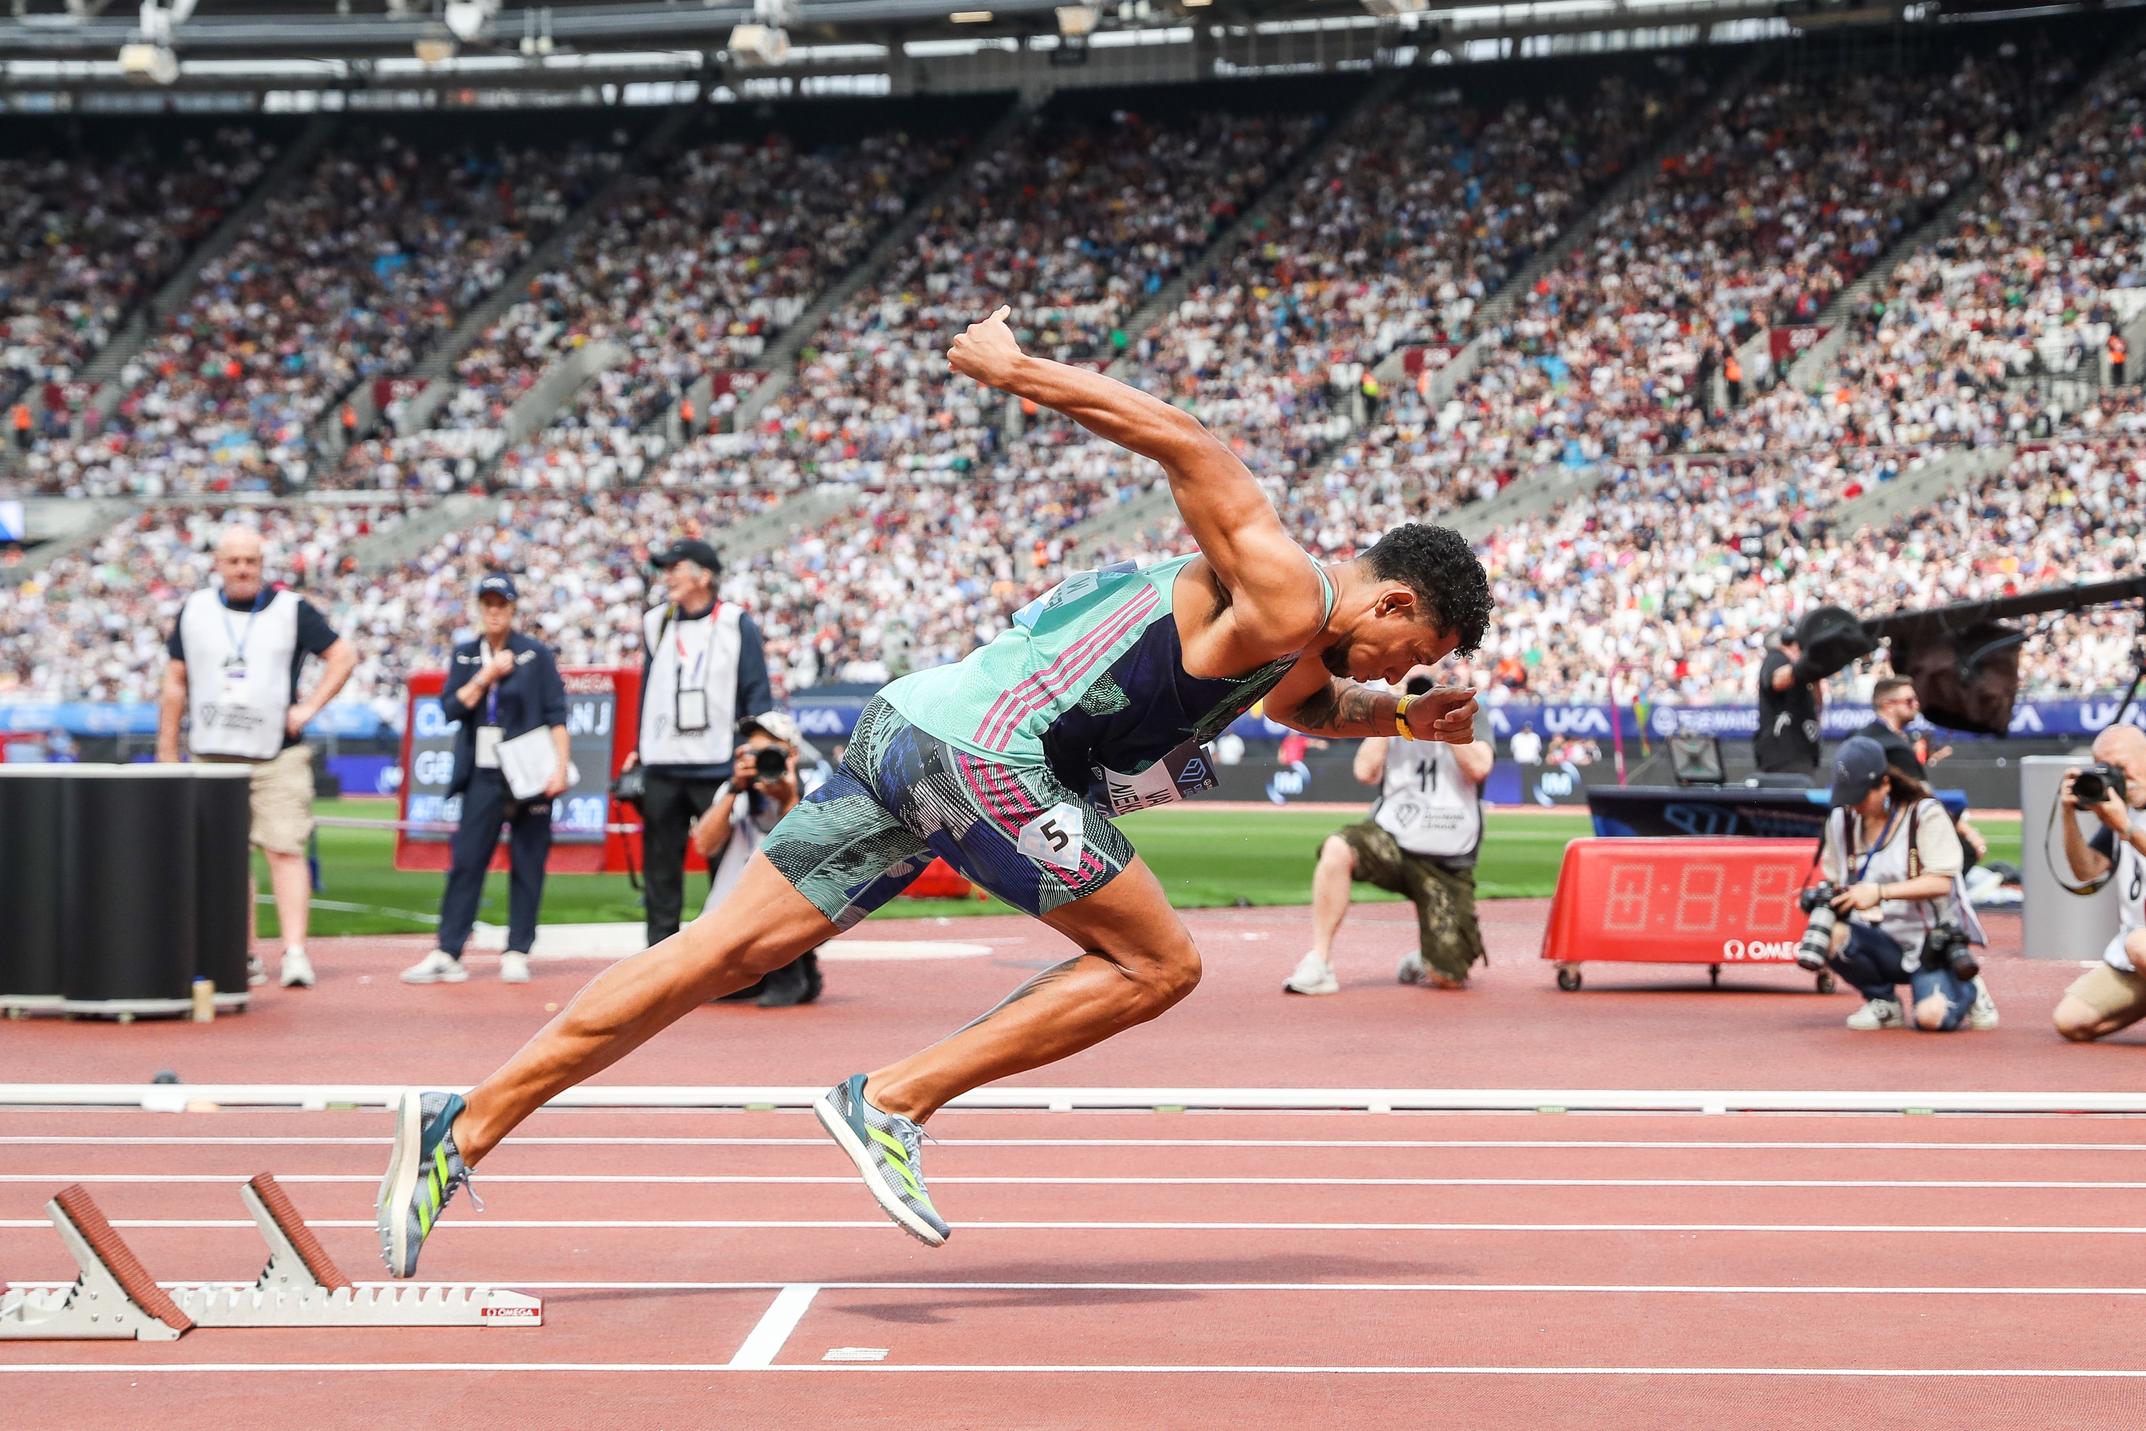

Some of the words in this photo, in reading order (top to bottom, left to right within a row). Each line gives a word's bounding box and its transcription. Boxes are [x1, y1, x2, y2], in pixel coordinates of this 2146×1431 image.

[1544, 707, 1610, 733] UKA
[1416, 758, 1437, 793] 11
[1040, 818, 1069, 853] 5
[498, 1308, 533, 1317] OMEGA
